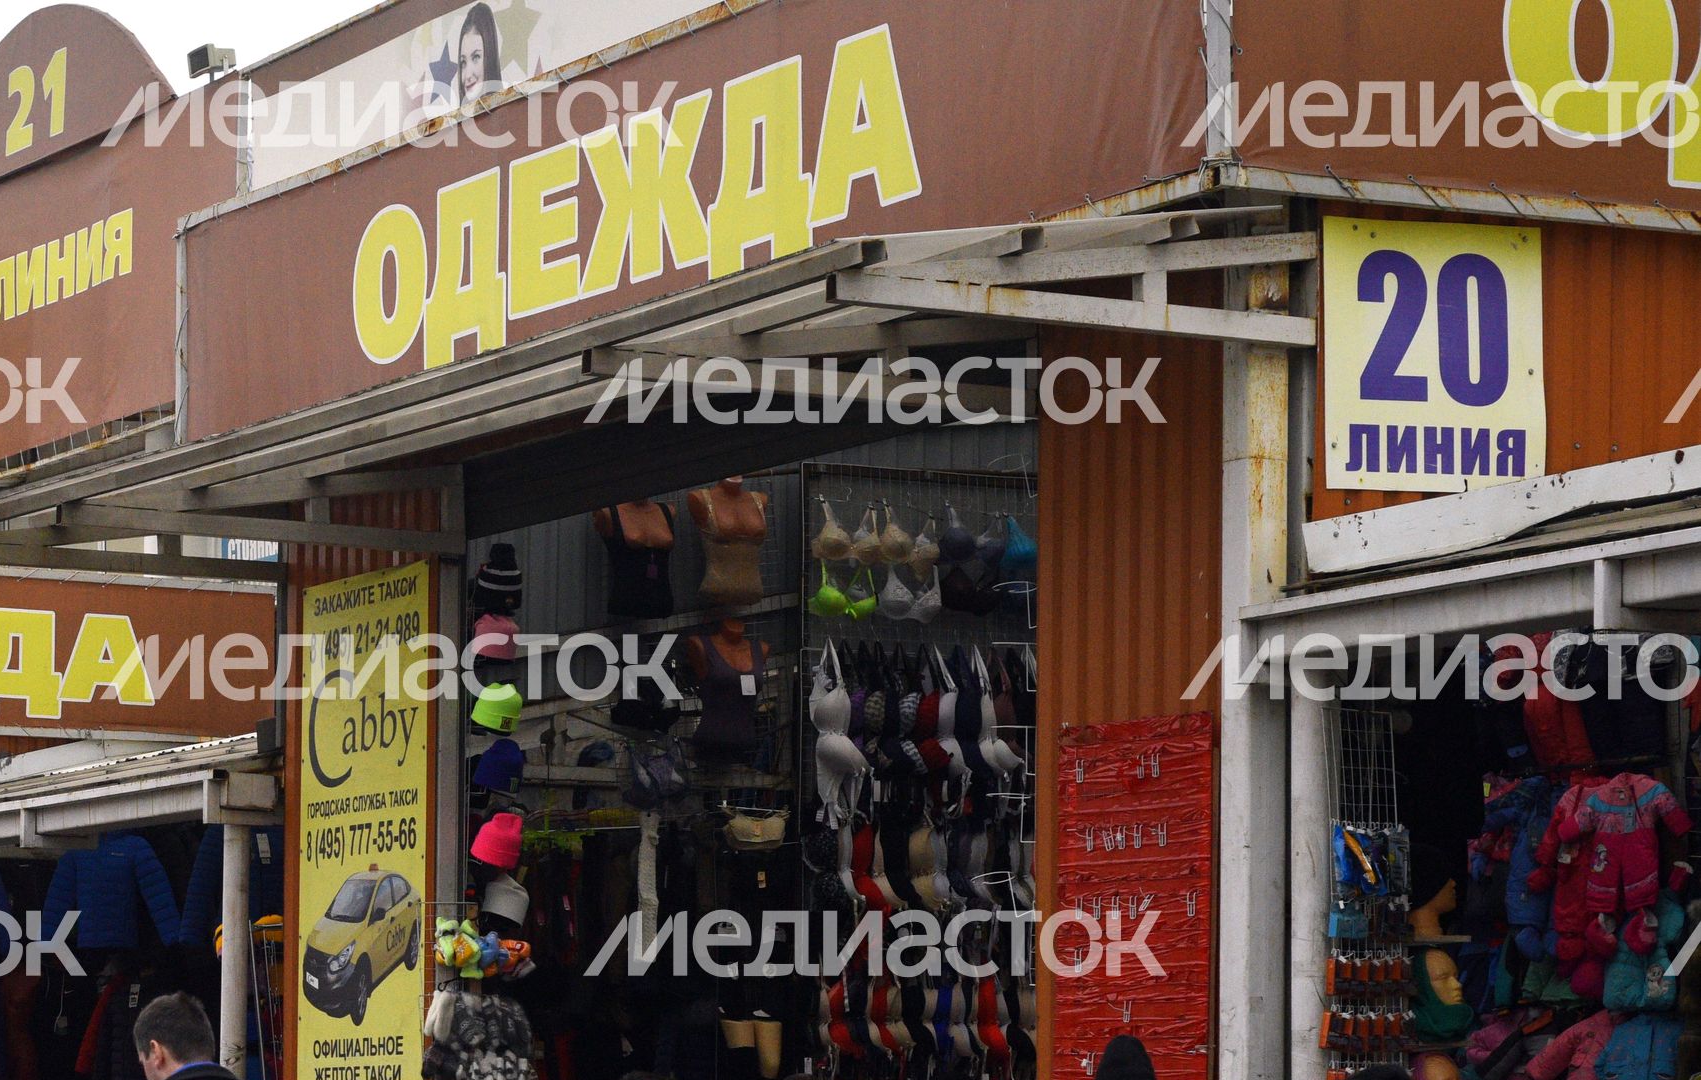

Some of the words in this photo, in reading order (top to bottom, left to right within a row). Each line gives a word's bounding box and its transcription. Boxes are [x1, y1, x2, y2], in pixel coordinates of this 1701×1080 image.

[5, 46, 68, 157] 21
[352, 22, 923, 371] ОДЕЖДА
[1356, 249, 1510, 408] 20
[1345, 423, 1527, 477] ЛИНИЯ
[313, 584, 375, 617] ЗАКАЖИТЕ
[377, 574, 417, 601] ТАКСИ
[355, 610, 420, 656] 21-21-989
[307, 668, 420, 789] Cabby
[307, 795, 351, 820] ГОРОДСКАЯ
[351, 790, 387, 815] СЛУЖБА
[388, 788, 419, 808] ТАКСИ
[306, 830, 313, 863] 8
[315, 825, 346, 869] (495)
[349, 816, 418, 857] 777-55-66
[312, 1035, 405, 1061] ОФИЦИАЛЬНОЕ
